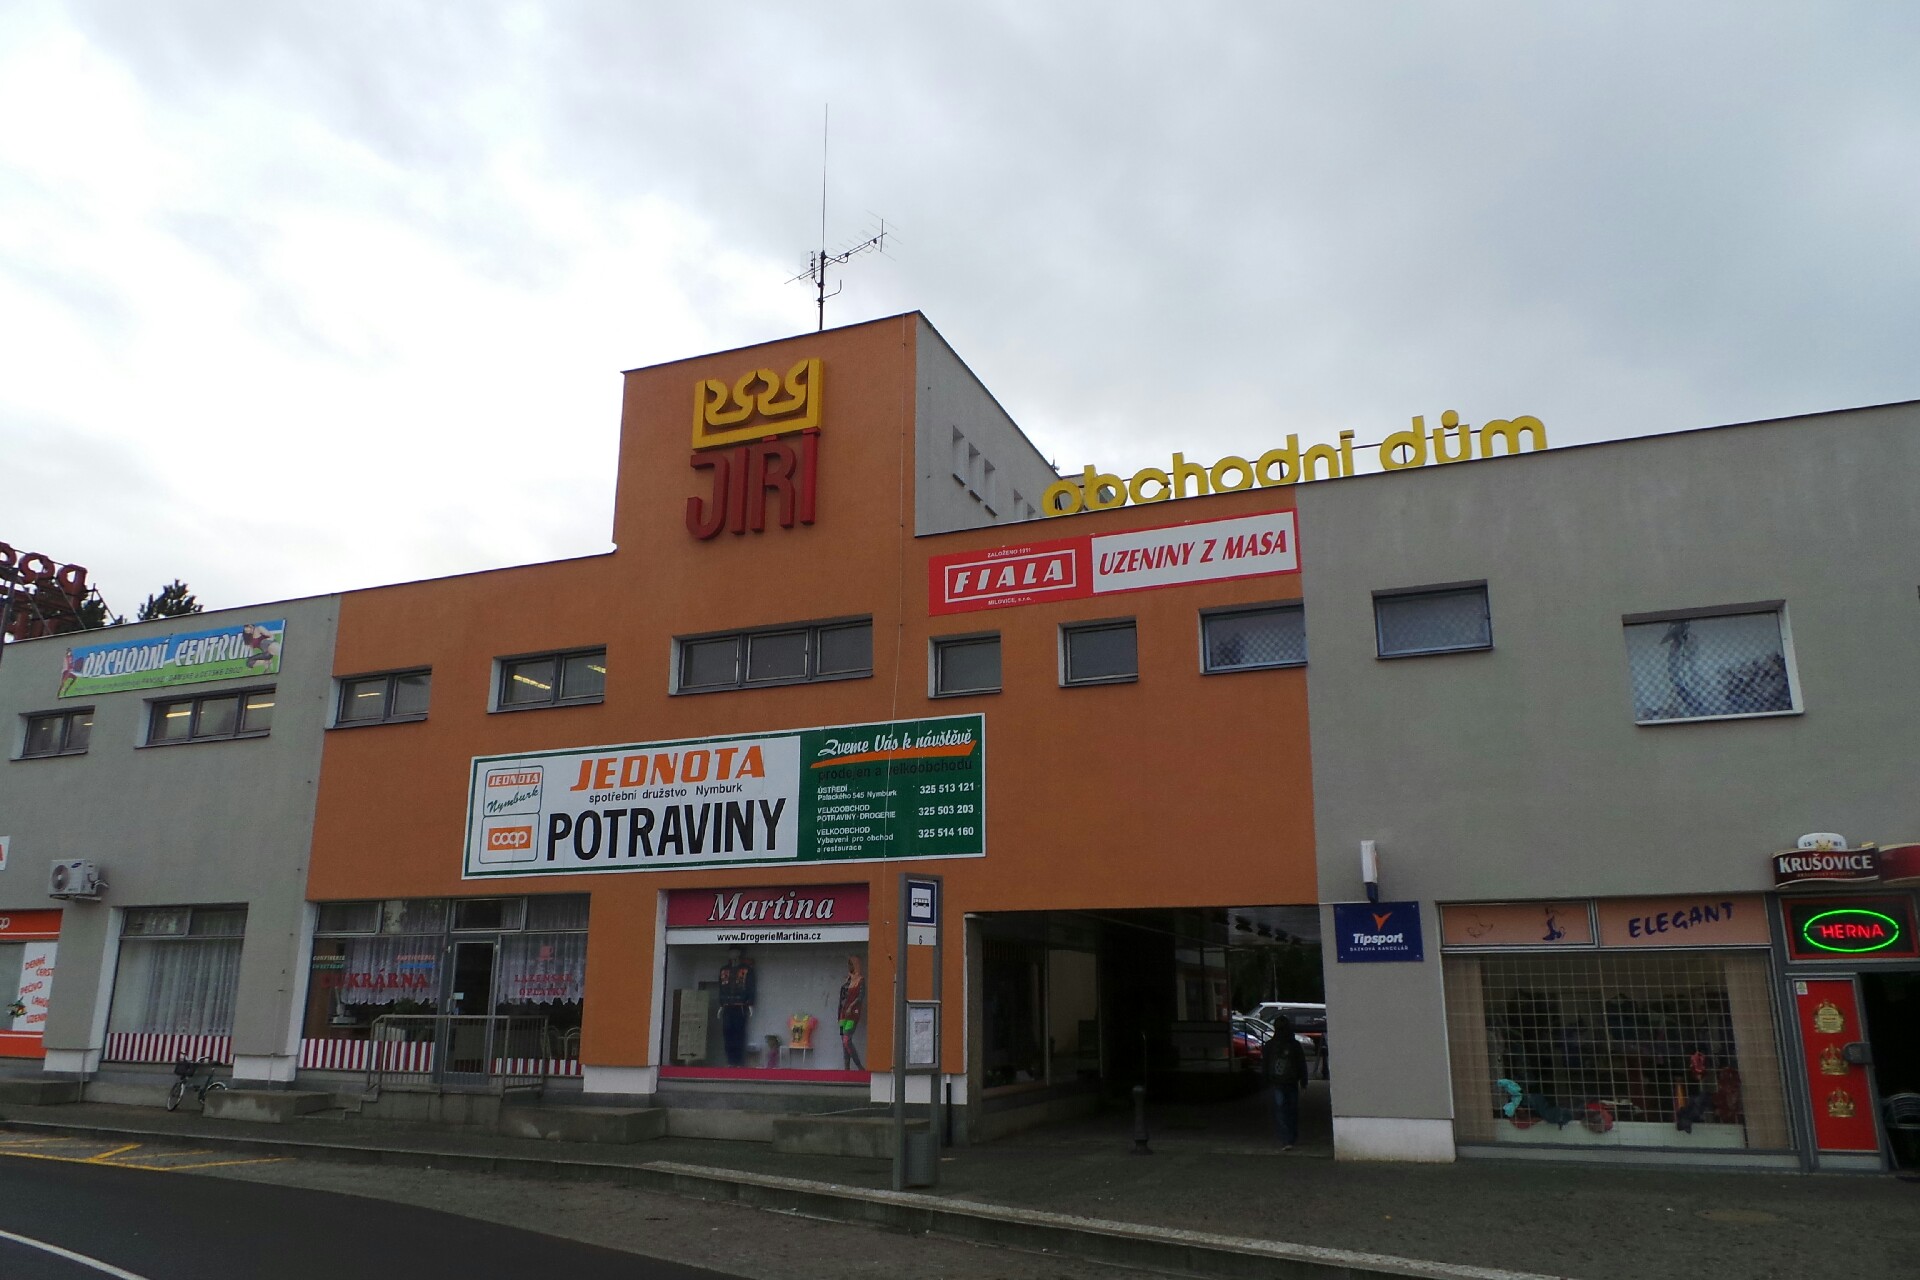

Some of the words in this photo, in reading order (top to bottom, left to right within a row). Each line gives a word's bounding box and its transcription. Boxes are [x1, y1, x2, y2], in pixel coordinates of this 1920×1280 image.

[1043, 429, 1355, 517] obchodní
[1099, 541, 1195, 576] UZENINY
[1200, 538, 1217, 564] Z
[1222, 529, 1287, 561] MASA
[953, 559, 1063, 594] FIALA
[82, 638, 170, 679] OBCHODNÍ
[174, 631, 253, 668] CENTRUM
[817, 738, 869, 757] Zveme
[874, 733, 899, 753] Vás
[902, 732, 912, 750] k
[915, 728, 974, 749] návštěvě
[569, 745, 766, 792] JEDNOTA
[819, 766, 871, 783] prodejen
[874, 767, 882, 777] a
[886, 758, 973, 776] velkoobchodu
[489, 773, 539, 786] JEDNOTA
[919, 784, 936, 794] 325
[939, 783, 956, 793] 513
[958, 782, 974, 792] 121
[588, 789, 637, 805] spotřební
[642, 787, 688, 800] družstvo
[695, 782, 743, 797] Nymburk
[817, 784, 848, 794] ÚSTŘEDÍ
[817, 792, 852, 801] Palackého
[852, 791, 865, 799] 545
[866, 789, 897, 799] Nymburk
[486, 784, 539, 813] Nymburk
[816, 813, 856, 823] POTRAVINY
[859, 811, 896, 820] DROGERIE
[817, 804, 870, 814] VELKOOBCHOD
[918, 806, 936, 816] 325
[937, 805, 955, 815] 503
[956, 804, 974, 814] 203
[546, 797, 787, 862] POTRAVINY
[816, 826, 871, 836] VELKOOBCHOD
[866, 833, 894, 842] obchod
[918, 828, 936, 839] 325
[937, 827, 955, 837] 514
[957, 826, 974, 836] 160
[491, 830, 528, 848] coop
[823, 844, 862, 852] restaurace
[1779, 853, 1874, 874] KRUŠOVICE
[708, 890, 834, 921] Martina
[1628, 901, 1734, 939] ELEGANT
[716, 931, 822, 943] www.DrogerieMartina.cz
[918, 934, 923, 945] 6
[1353, 932, 1404, 946] Tipsport
[1820, 923, 1885, 939] HERNA
[320, 968, 431, 989] CUKRÁRNA
